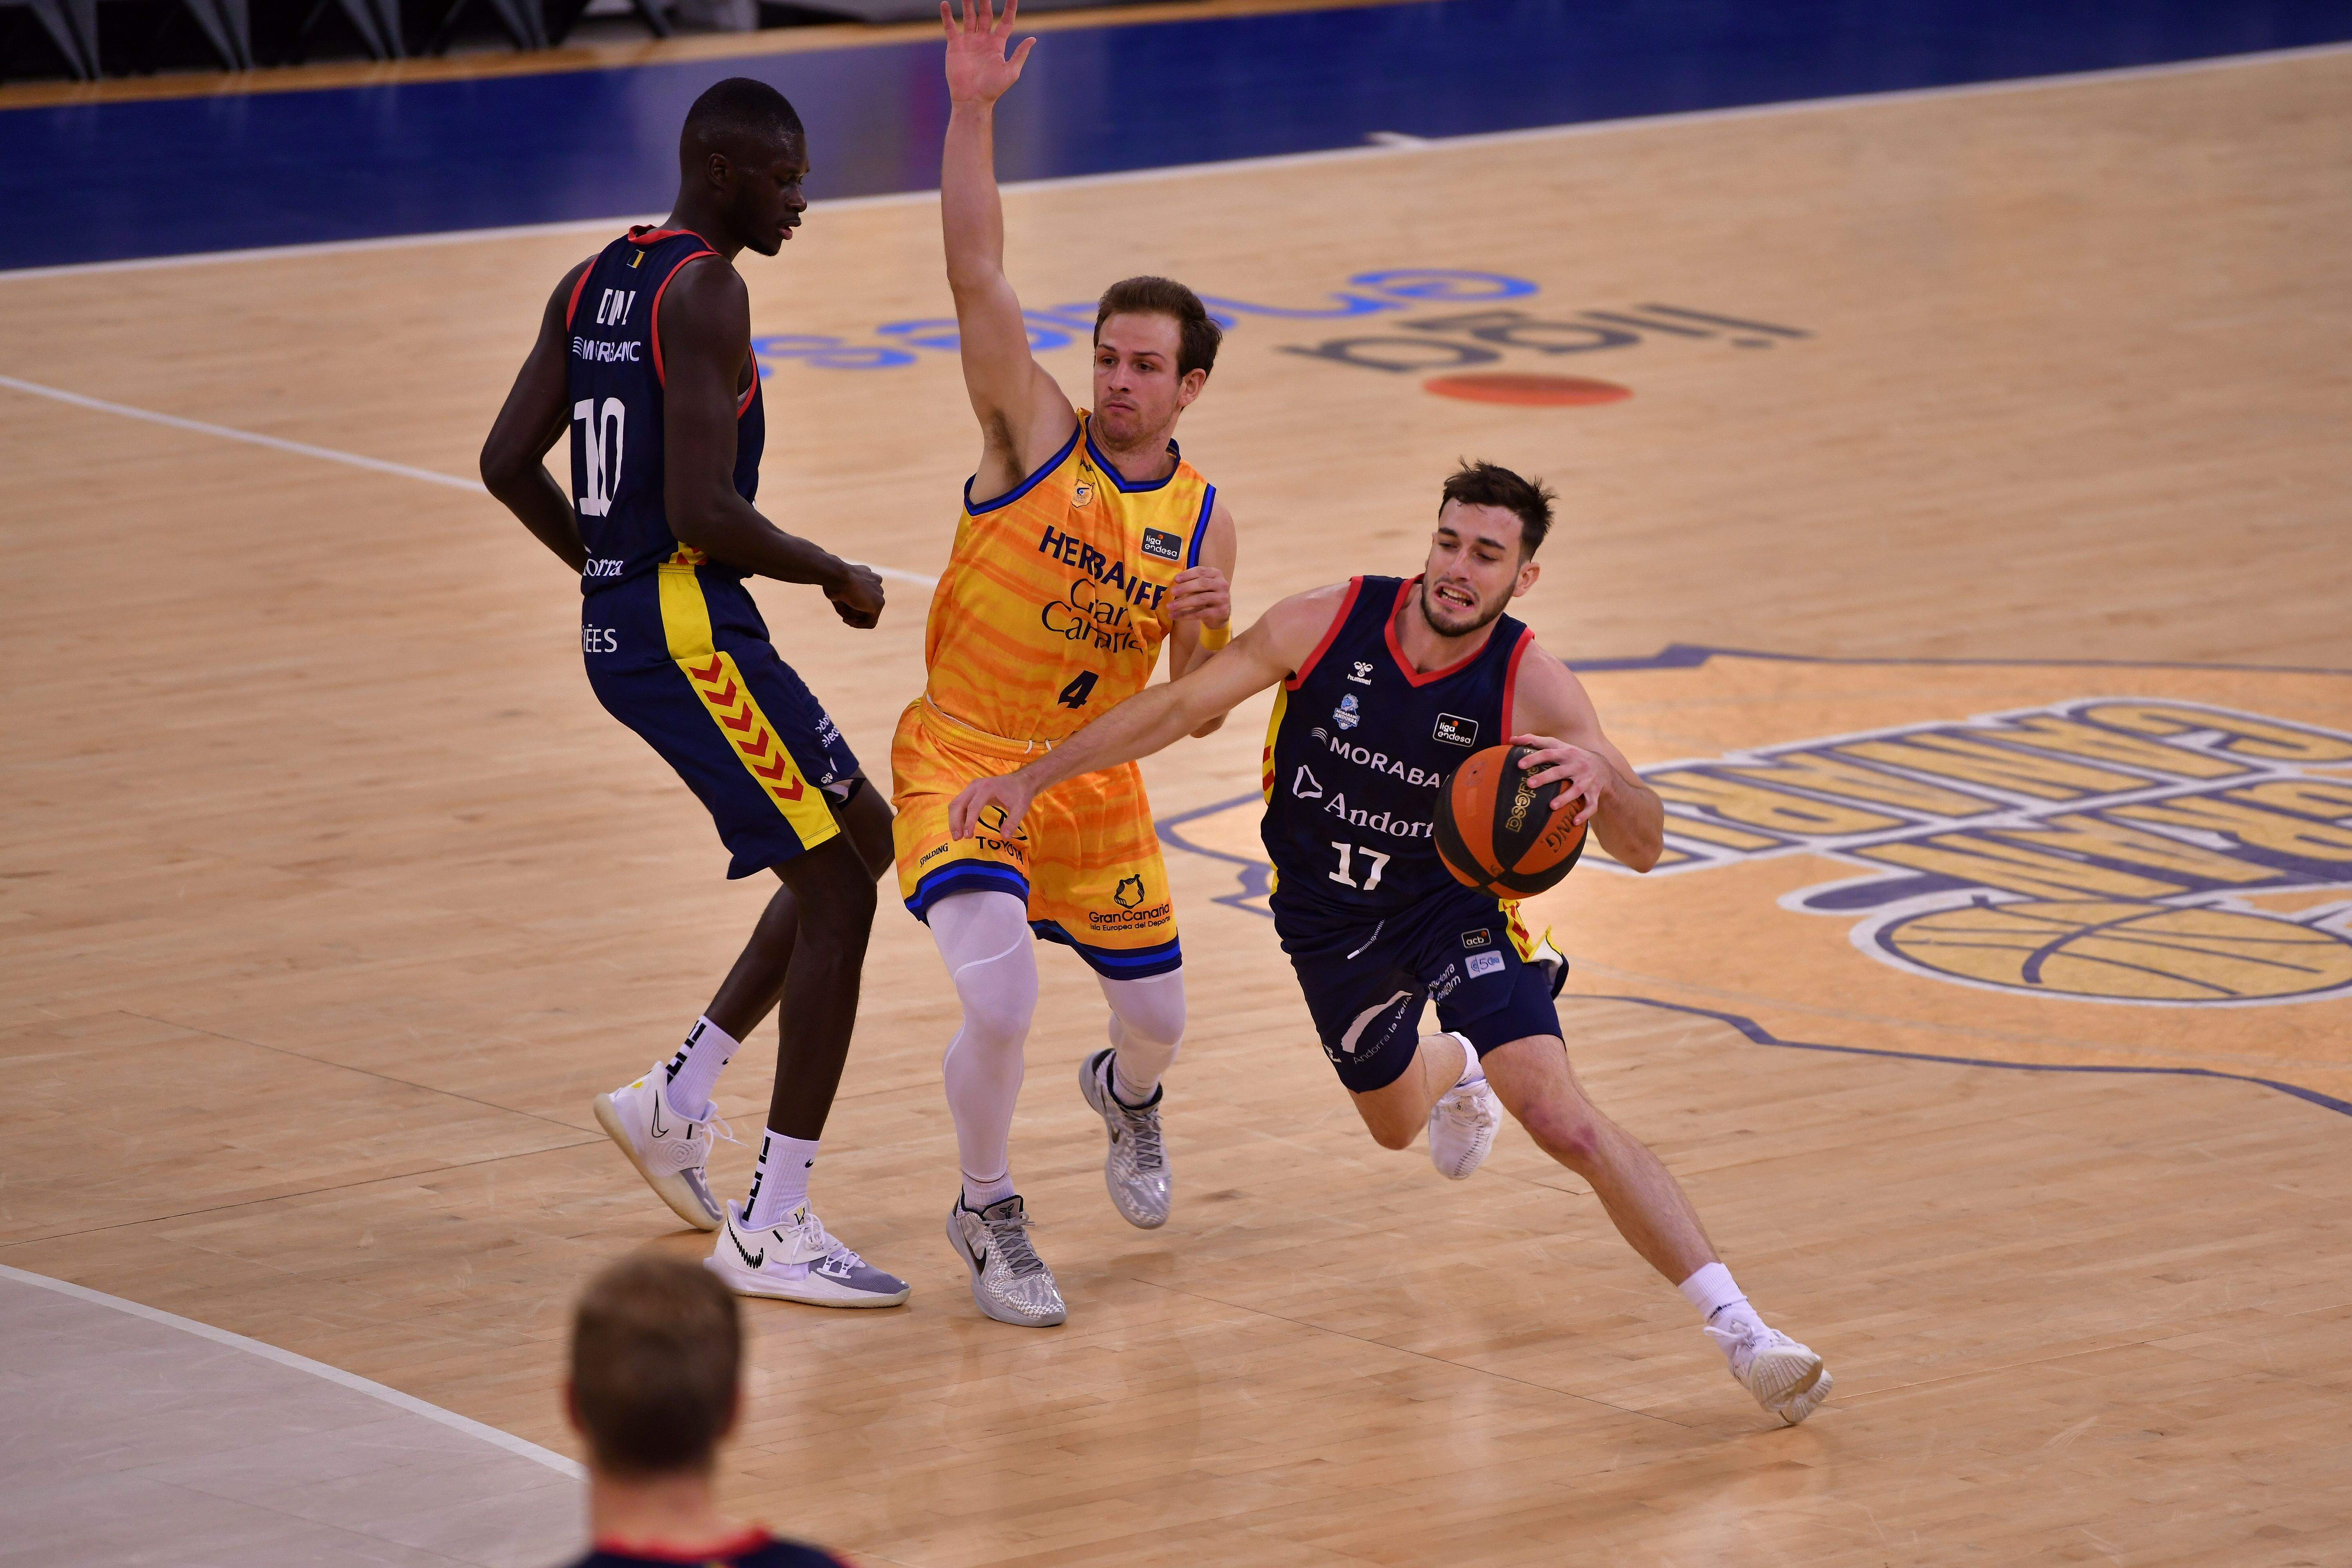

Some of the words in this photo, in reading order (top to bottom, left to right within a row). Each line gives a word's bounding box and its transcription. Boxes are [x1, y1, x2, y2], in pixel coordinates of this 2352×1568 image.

[574, 397, 625, 517] 10
[1146, 535, 1161, 545] liga
[1145, 543, 1177, 557] endesa
[582, 558, 624, 577] orra
[1347, 673, 1372, 686] hummel
[1057, 670, 1099, 709] 4
[1334, 713, 1356, 725] ANDORRA
[1439, 722, 1455, 733] liga
[1438, 731, 1471, 744] endesa
[1330, 737, 1450, 788] MORABA
[920, 842, 949, 869] SPALDING
[975, 836, 1024, 865] TOYOTA
[1329, 841, 1390, 890] 17
[1148, 915, 1171, 927] Deporte
[1466, 936, 1484, 946] acb
[1353, 1034, 1390, 1065] Andorra
[1388, 1022, 1397, 1033] la
[1395, 997, 1412, 1020] Vella
